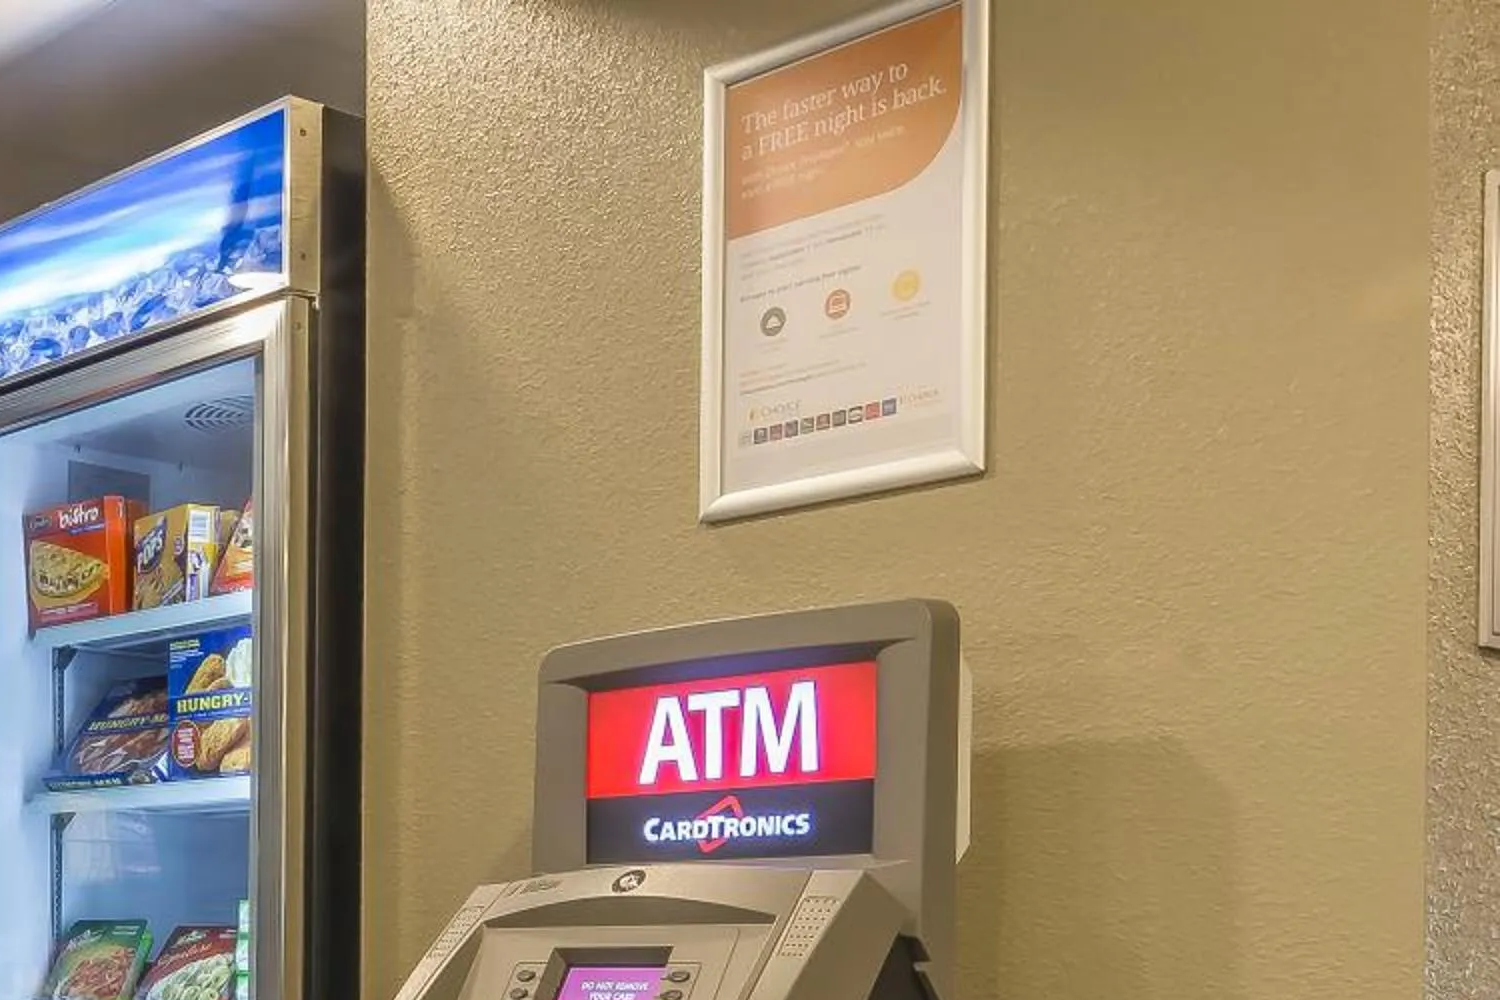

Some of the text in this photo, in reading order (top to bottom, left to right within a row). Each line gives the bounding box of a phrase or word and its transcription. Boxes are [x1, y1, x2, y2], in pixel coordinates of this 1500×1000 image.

[741, 63, 908, 134] The faster way to
[741, 145, 753, 161] a
[758, 121, 810, 156] FREE
[814, 103, 865, 136] night
[872, 96, 888, 118] is
[892, 76, 947, 110] back.
[59, 504, 99, 530] bistro
[638, 680, 820, 785] ATM
[643, 812, 811, 842] CARDTRONICS
